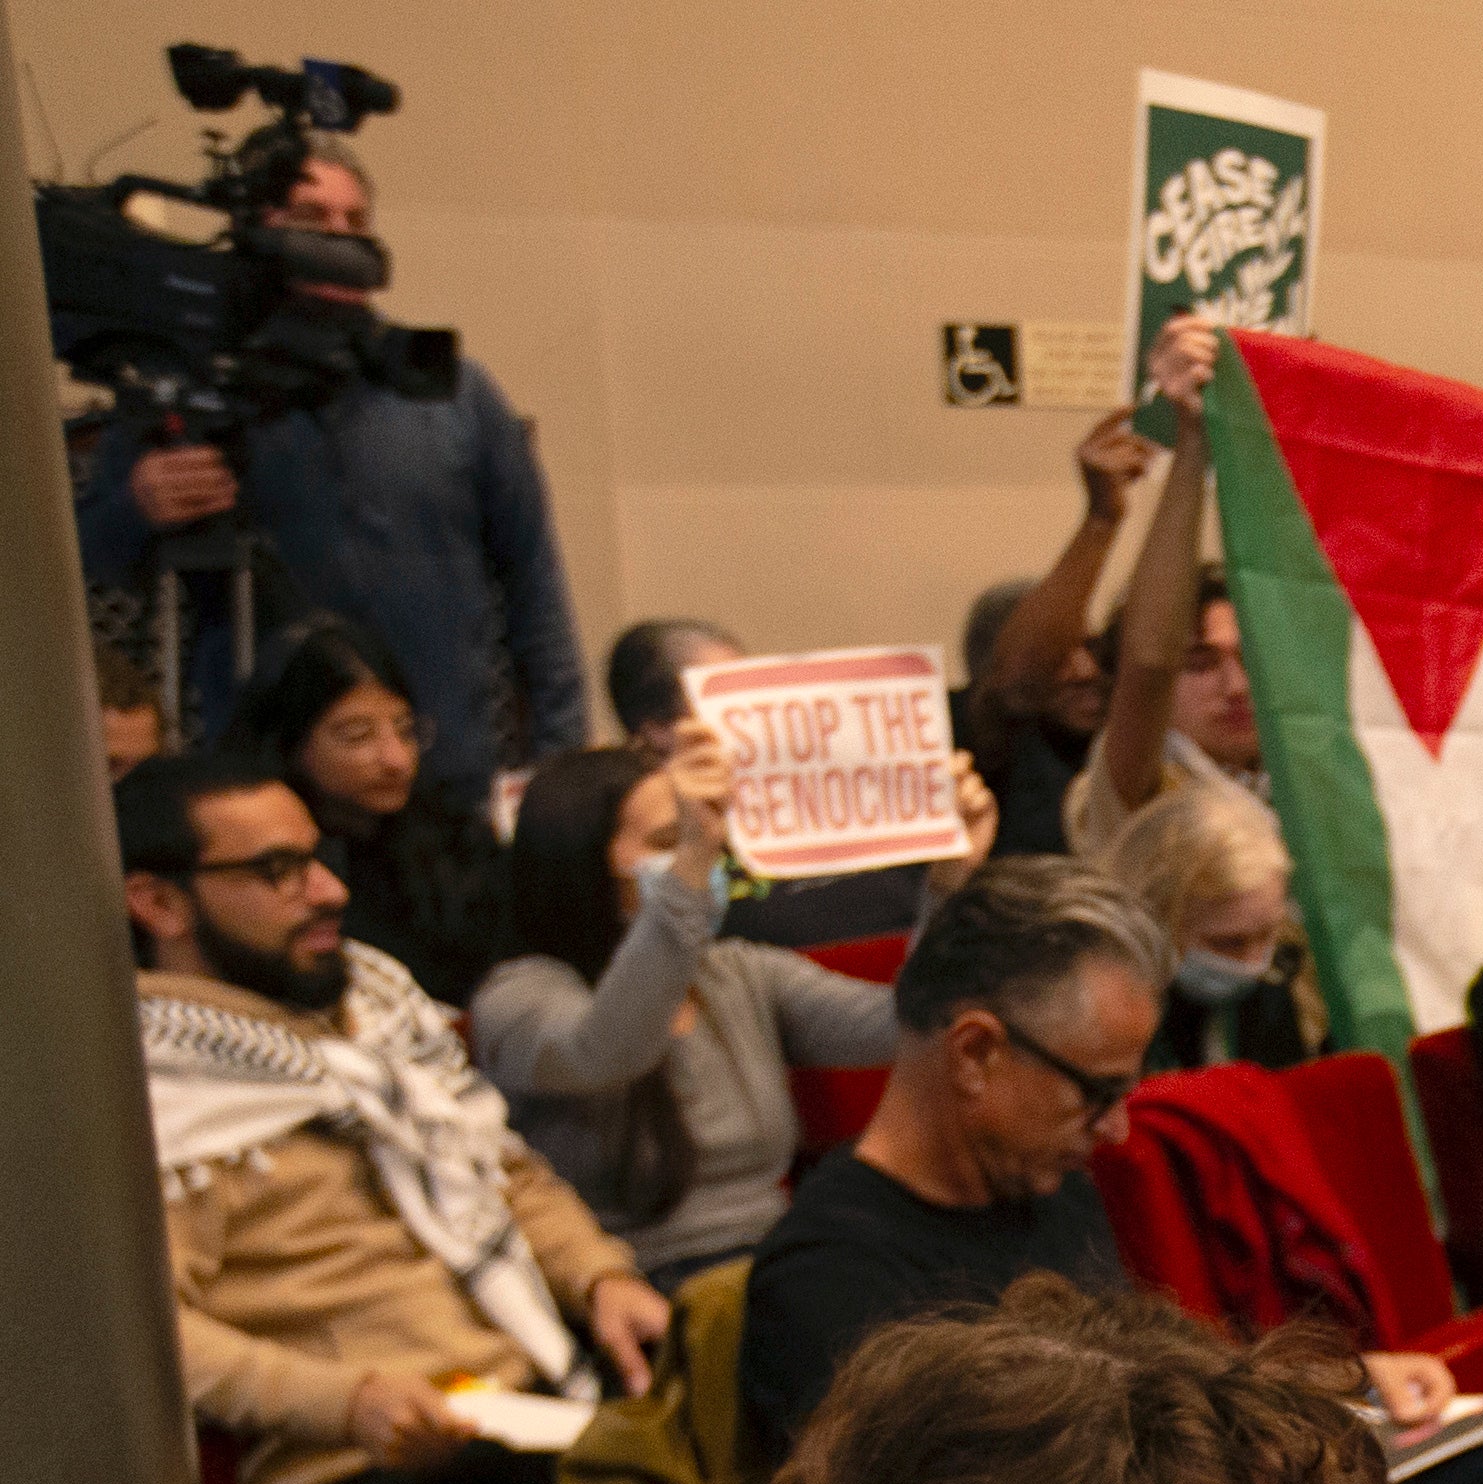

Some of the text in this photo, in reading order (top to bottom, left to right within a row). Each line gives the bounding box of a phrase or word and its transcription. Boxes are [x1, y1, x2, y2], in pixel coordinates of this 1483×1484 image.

[1145, 148, 1280, 284] CEASE
[721, 689, 941, 768] STOP THE
[734, 758, 949, 840] GENOCIDE
